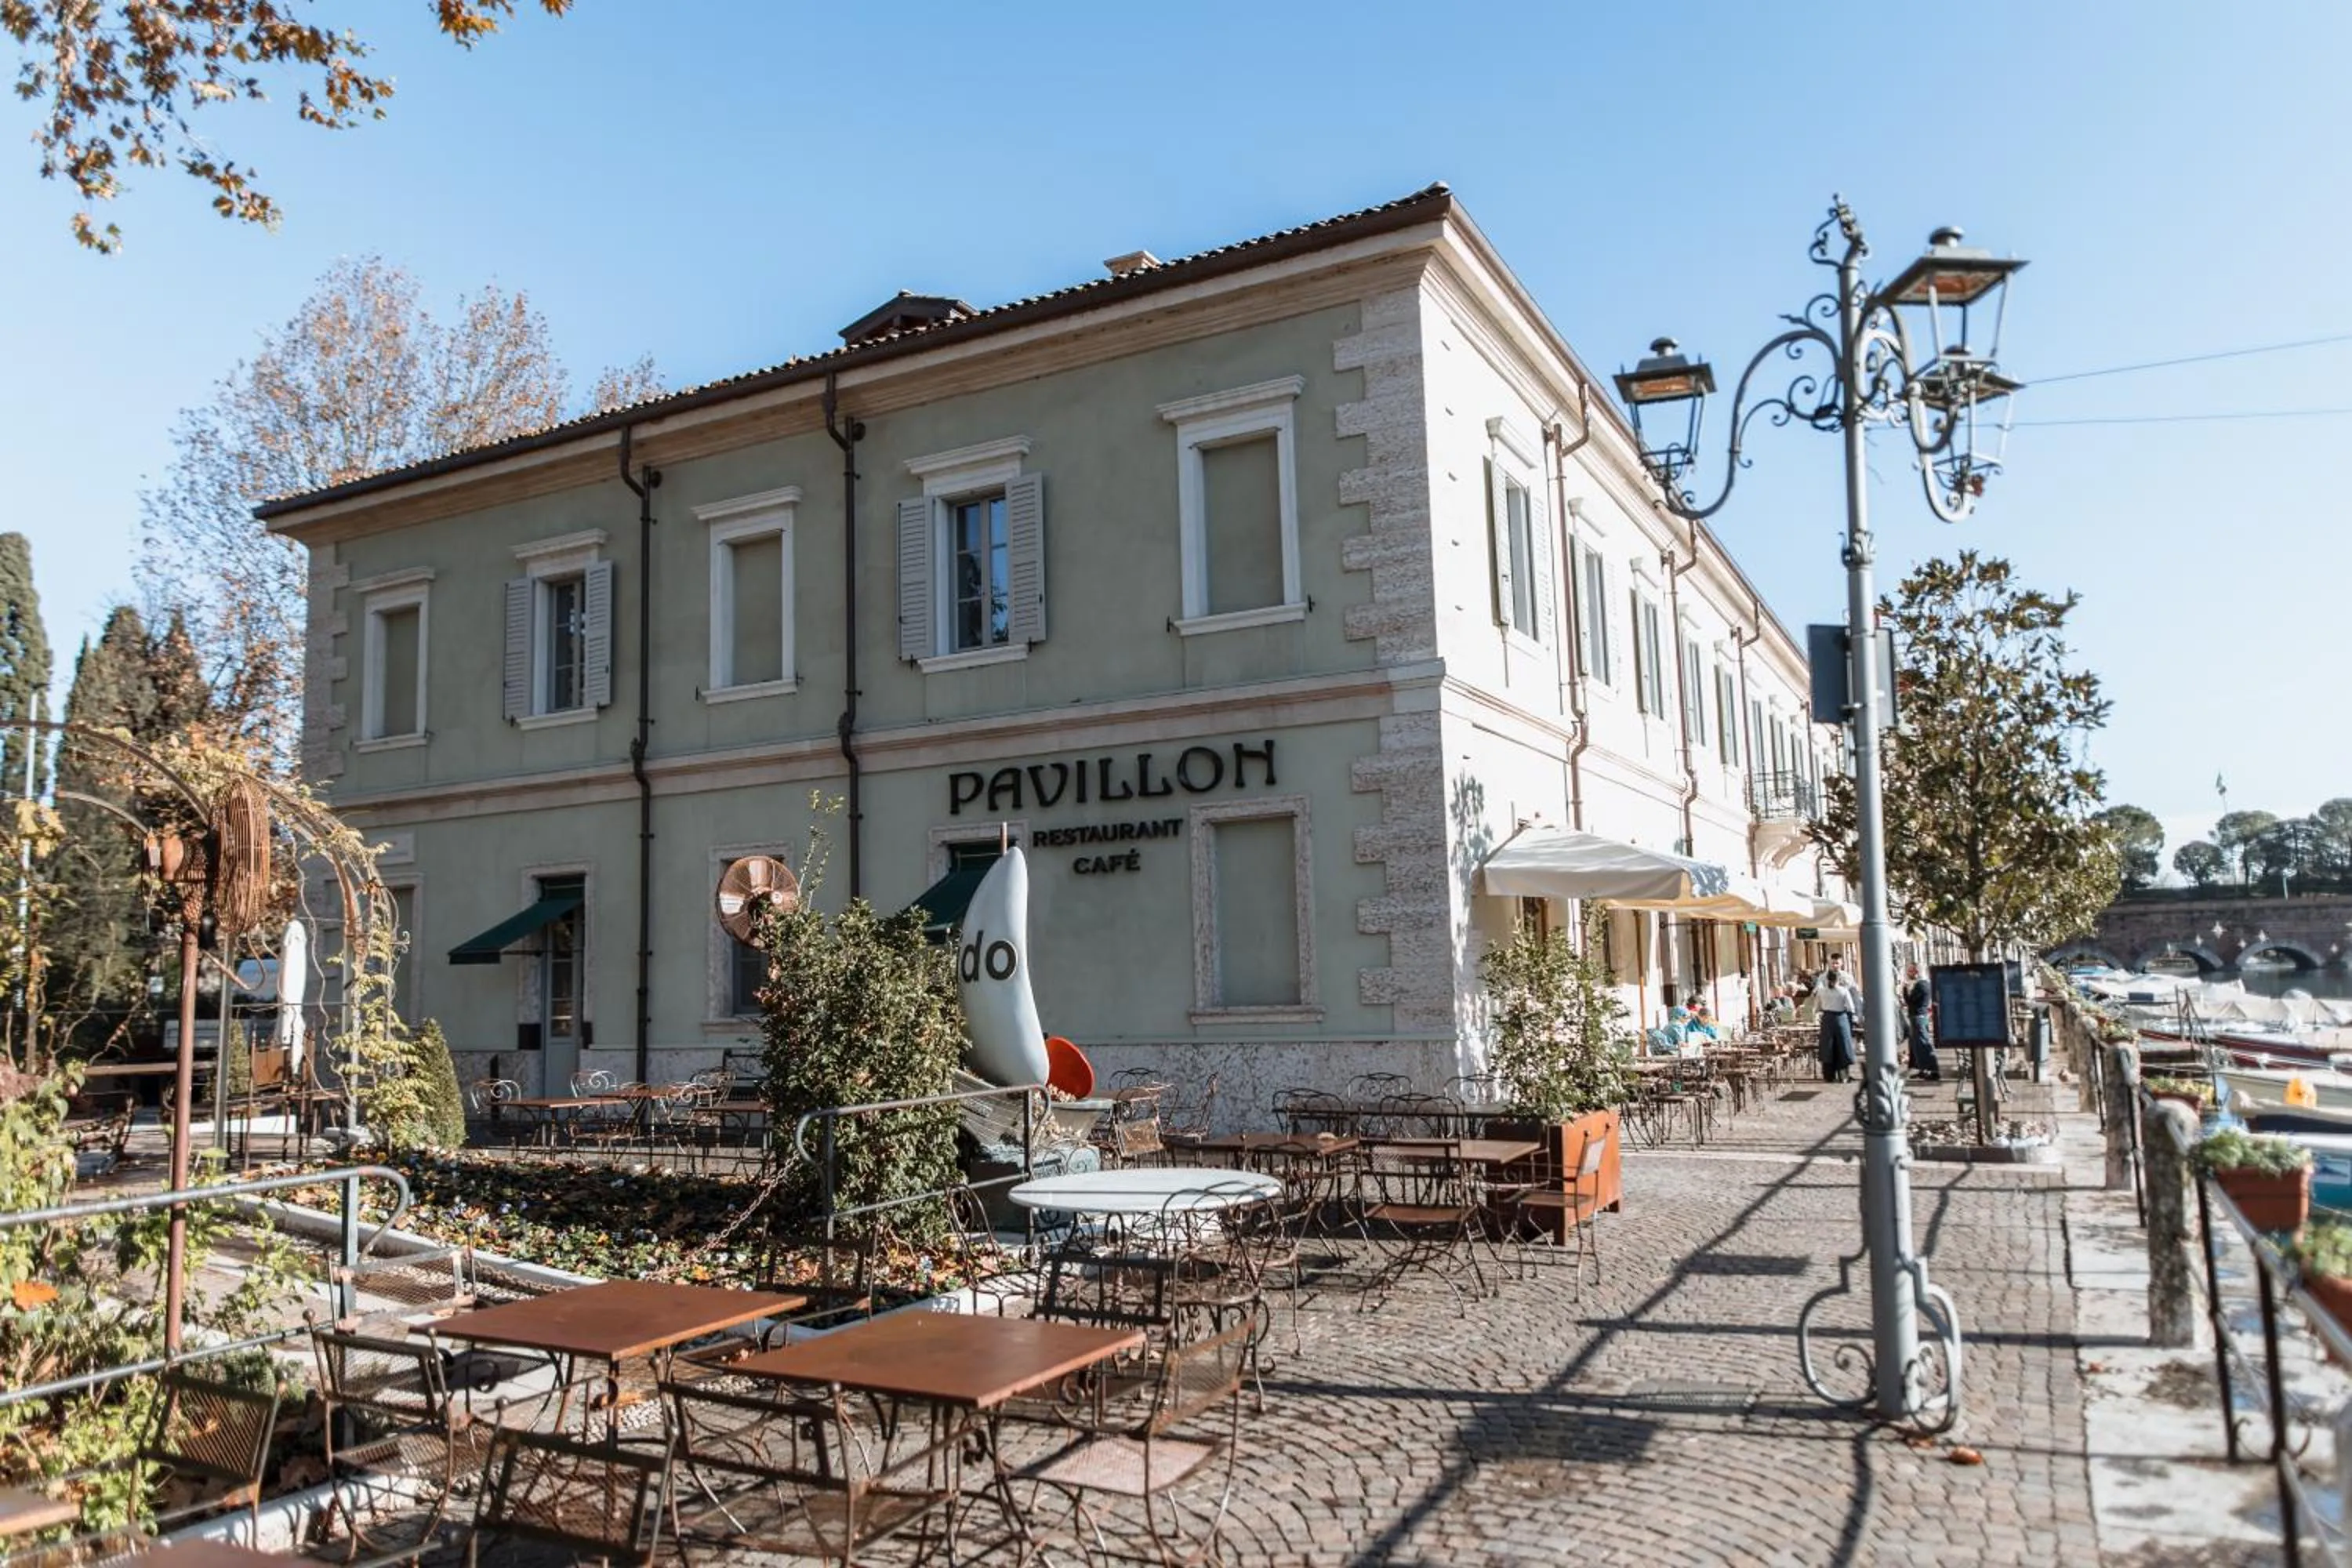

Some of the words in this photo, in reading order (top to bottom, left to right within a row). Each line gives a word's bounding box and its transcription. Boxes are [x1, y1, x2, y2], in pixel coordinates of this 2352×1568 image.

[949, 739, 1278, 815] PAVILLON
[1033, 818, 1184, 848] RESTAURANT
[1073, 848, 1141, 876] CAFÉ
